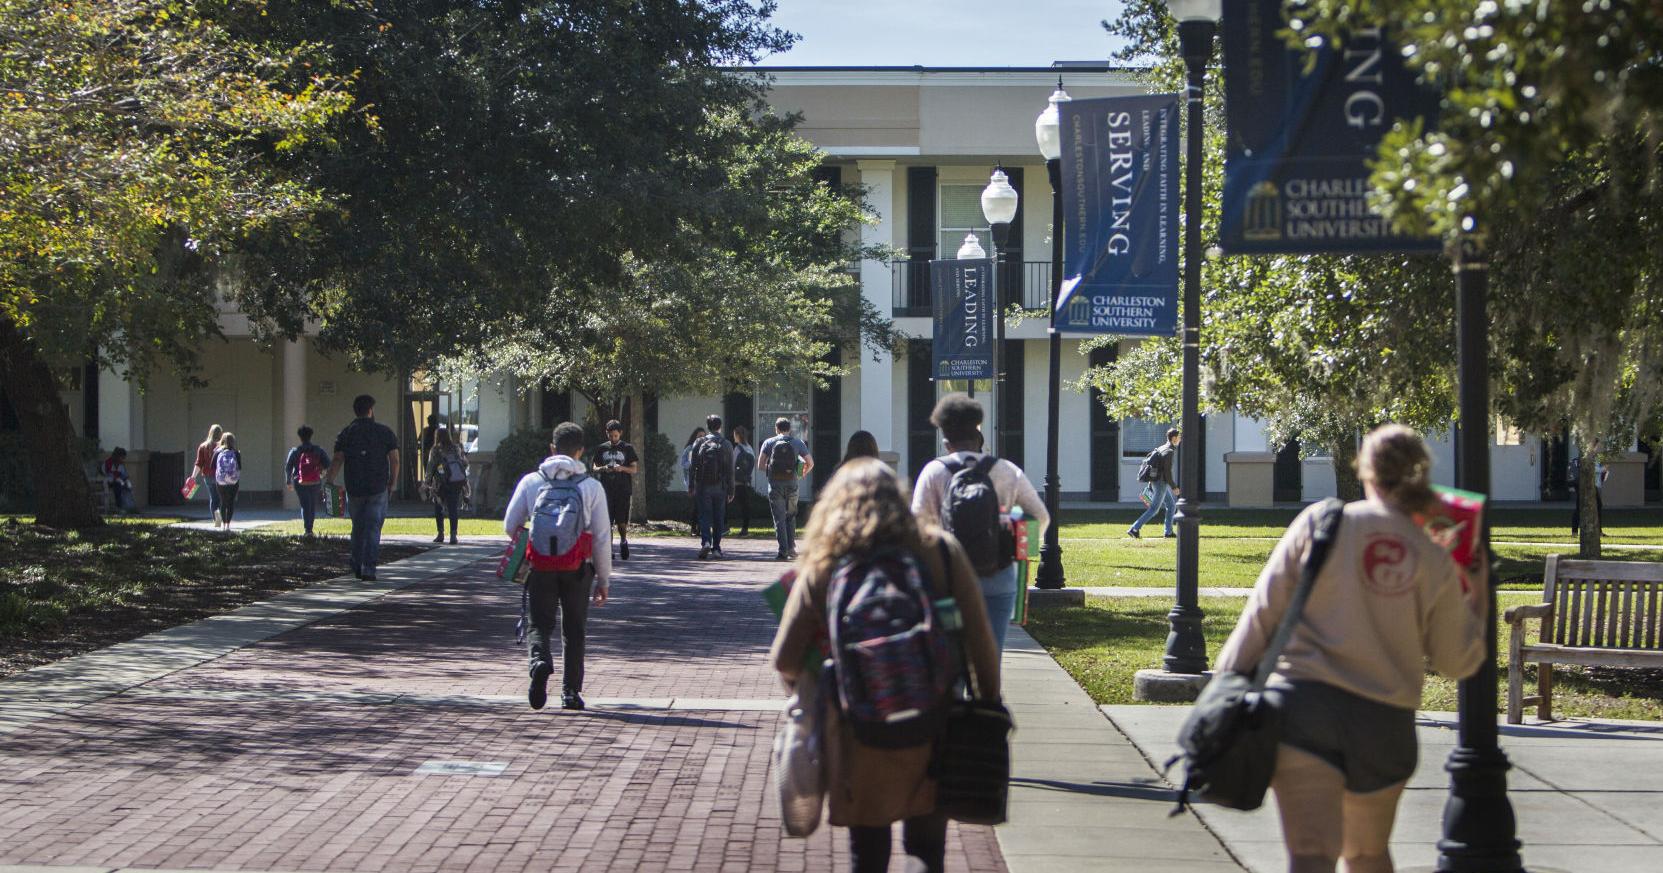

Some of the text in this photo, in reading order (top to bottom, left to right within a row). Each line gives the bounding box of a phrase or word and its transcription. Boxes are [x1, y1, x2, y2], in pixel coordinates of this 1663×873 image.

[1142, 151, 1151, 172] AND
[1107, 112, 1133, 256] SERVING
[1158, 108, 1168, 264] INTEGRATING FAITH IN LEARNING,
[1285, 178, 1364, 199] CHARLE
[1286, 199, 1369, 219] SOUTHE
[964, 268, 978, 348] LEADING
[1092, 295, 1166, 307] CHARLESTON
[1092, 306, 1154, 317] SOUTHERN
[1092, 317, 1157, 328] UNIVERSITY
